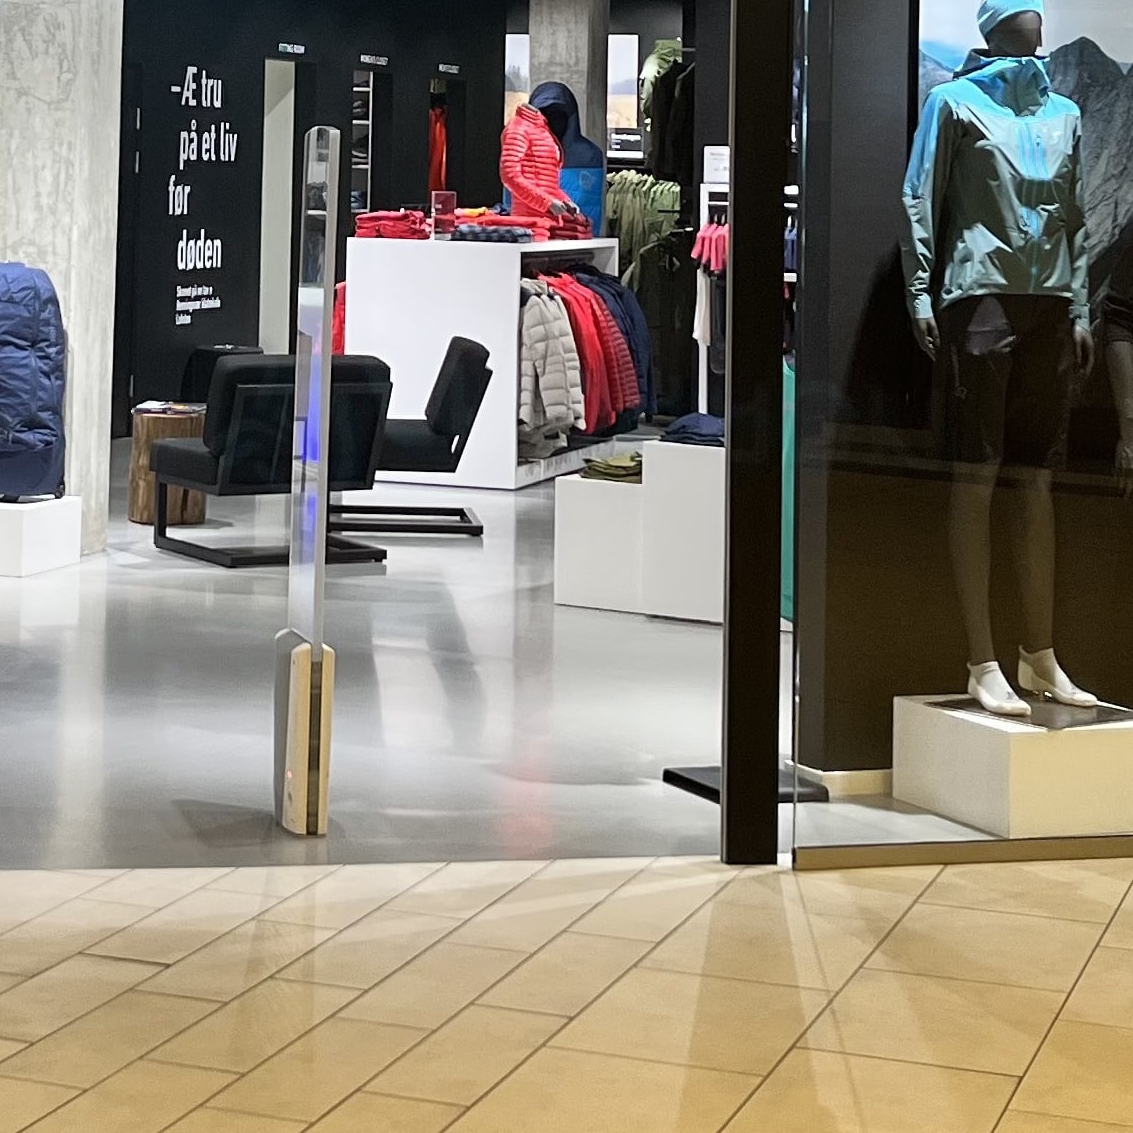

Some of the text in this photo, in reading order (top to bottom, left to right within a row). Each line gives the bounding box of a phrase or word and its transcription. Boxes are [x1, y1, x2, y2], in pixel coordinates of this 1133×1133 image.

[201, 69, 222, 108] tru
[179, 119, 238, 170] på et liv
[168, 174, 190, 216] før
[177, 228, 222, 270] døden
